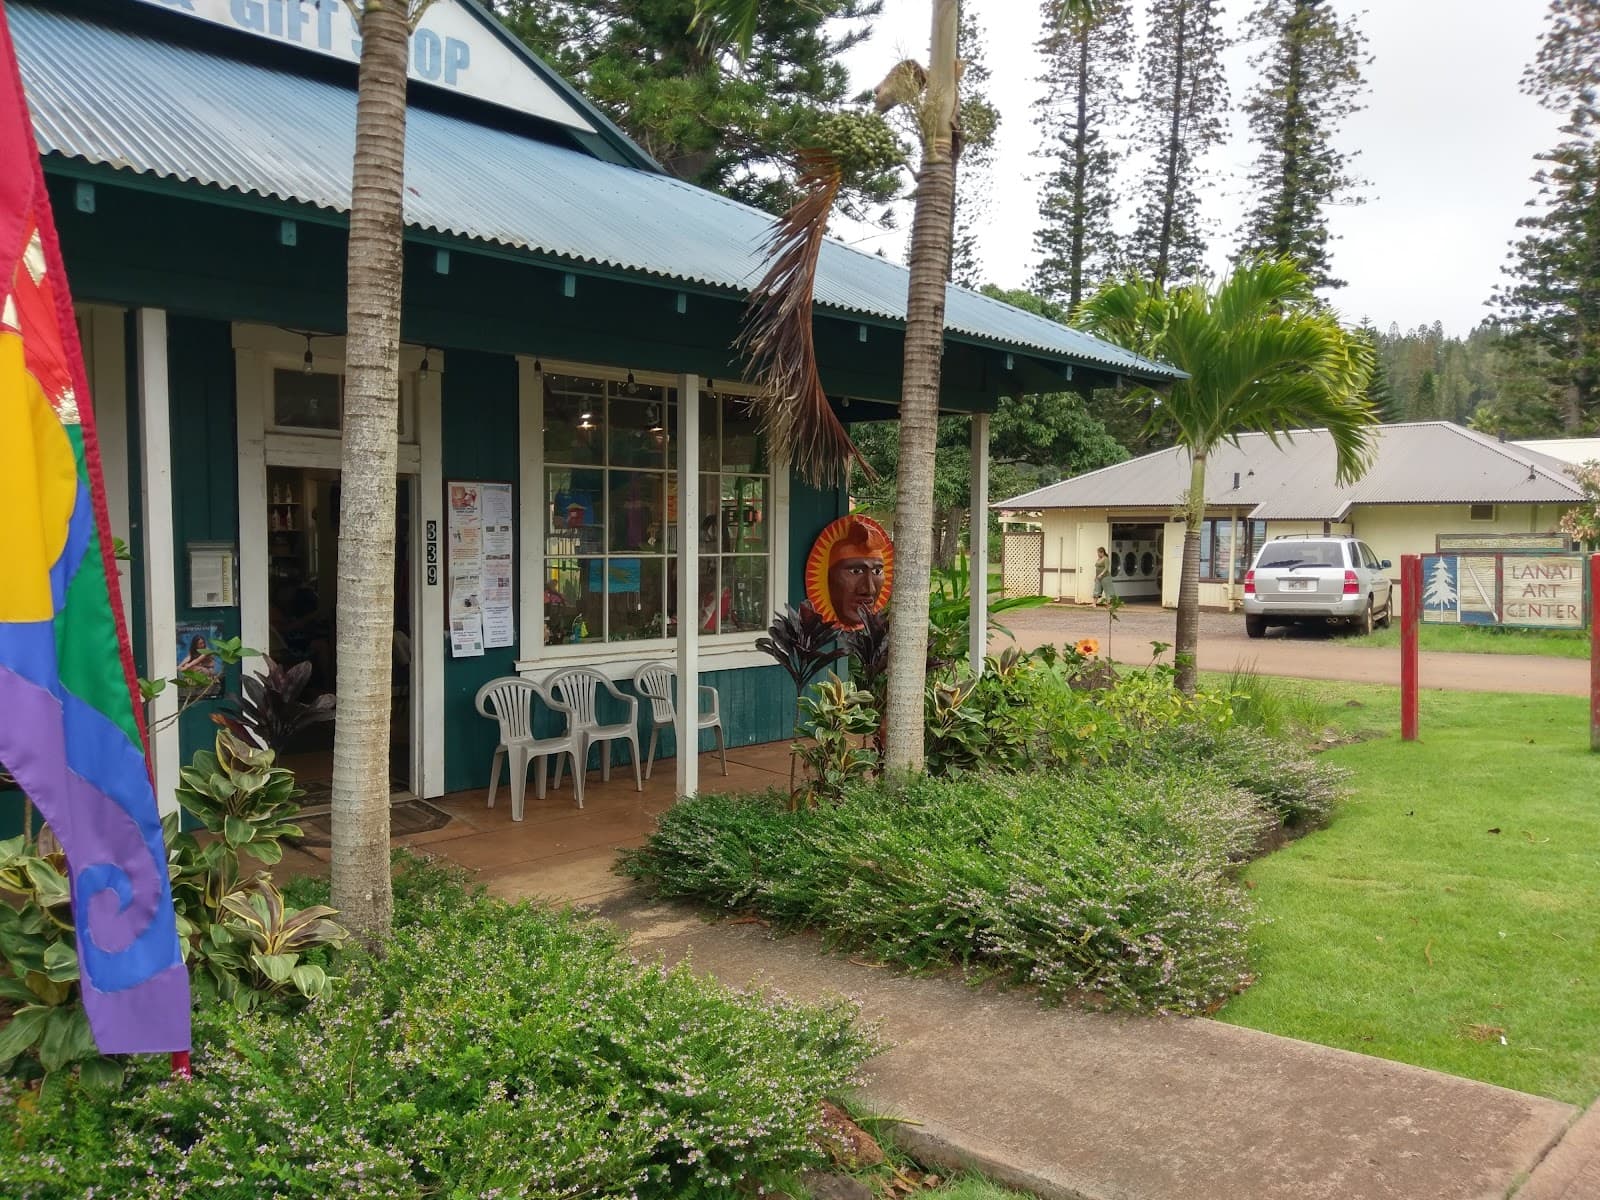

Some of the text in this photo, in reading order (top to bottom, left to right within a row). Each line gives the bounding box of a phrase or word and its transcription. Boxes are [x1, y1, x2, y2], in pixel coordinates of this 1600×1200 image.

[231, 0, 470, 86] GIFT OP
[427, 521, 437, 585] 339
[1522, 583, 1562, 598] ART
[1506, 603, 1578, 619] CENTER
